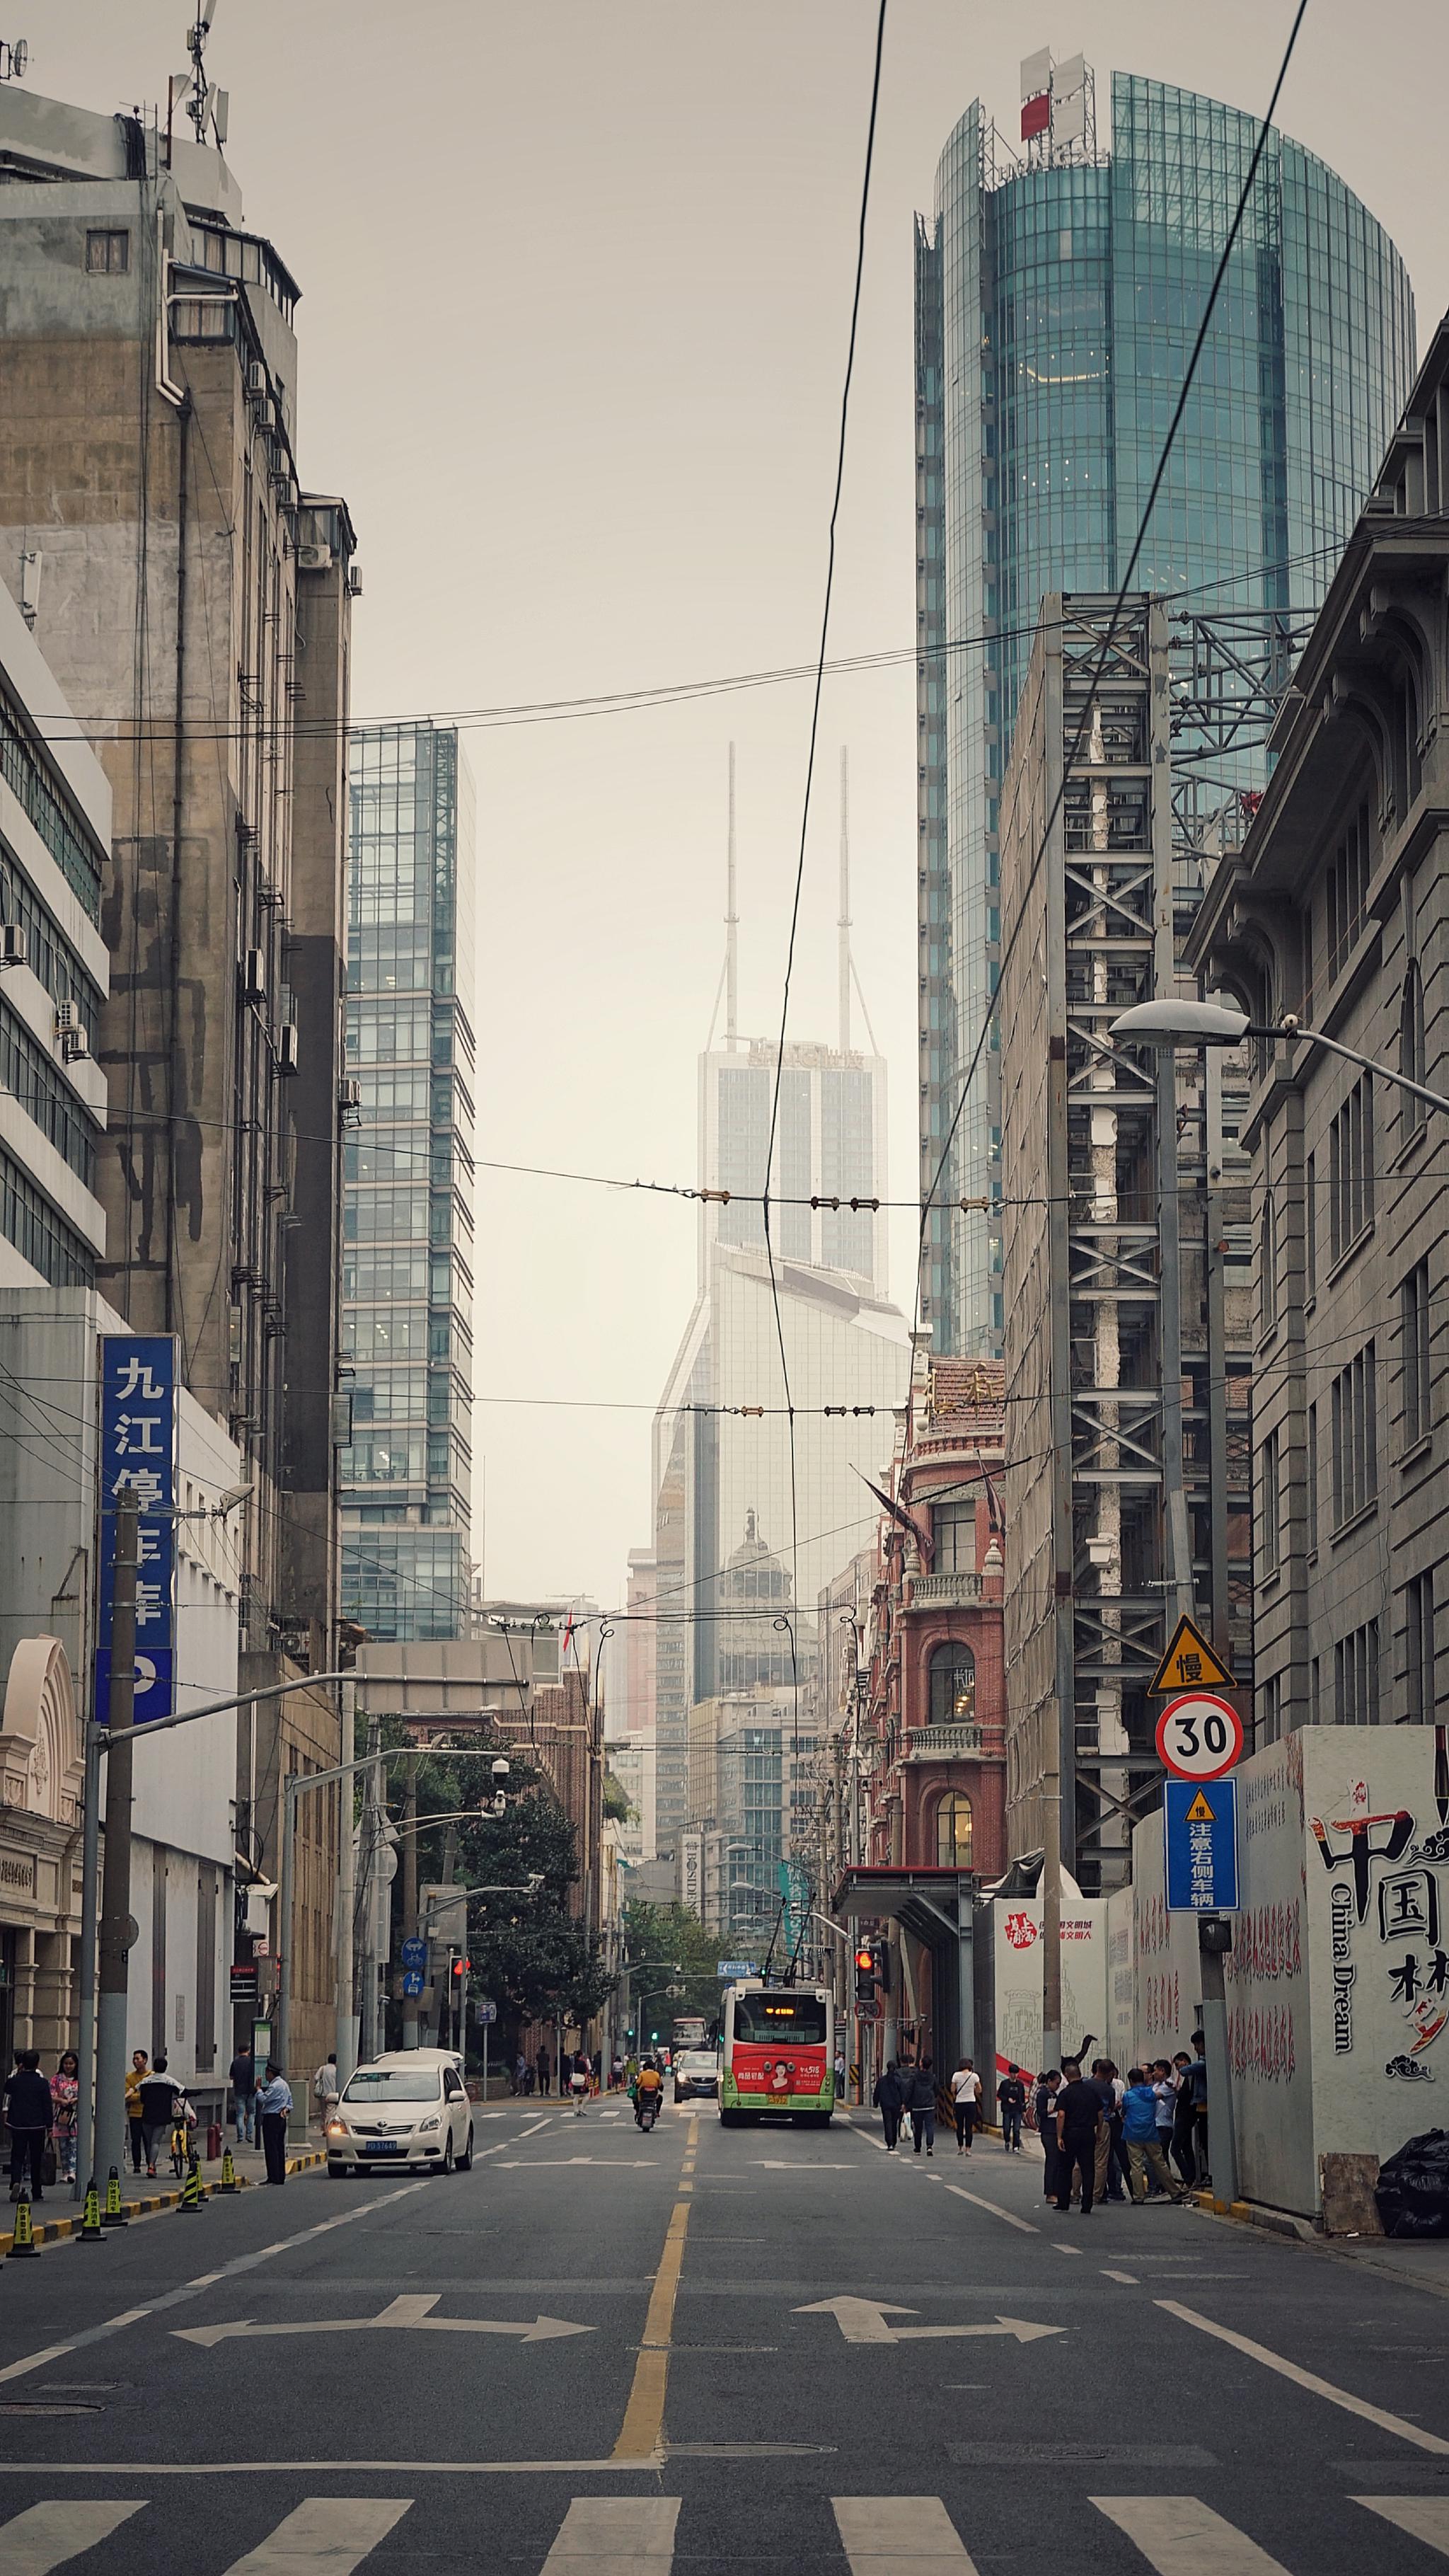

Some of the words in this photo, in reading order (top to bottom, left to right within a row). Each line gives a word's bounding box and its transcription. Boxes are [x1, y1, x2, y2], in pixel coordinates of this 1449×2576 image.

[1176, 1652, 1203, 1683] 慢
[1175, 1715, 1227, 1757] 30
[1189, 1822, 1214, 1907] 注意右侧车辆
[1307, 1778, 1449, 2054] 中国梦
[1331, 1882, 1353, 1960] China
[1333, 1965, 1354, 2052] Dream
